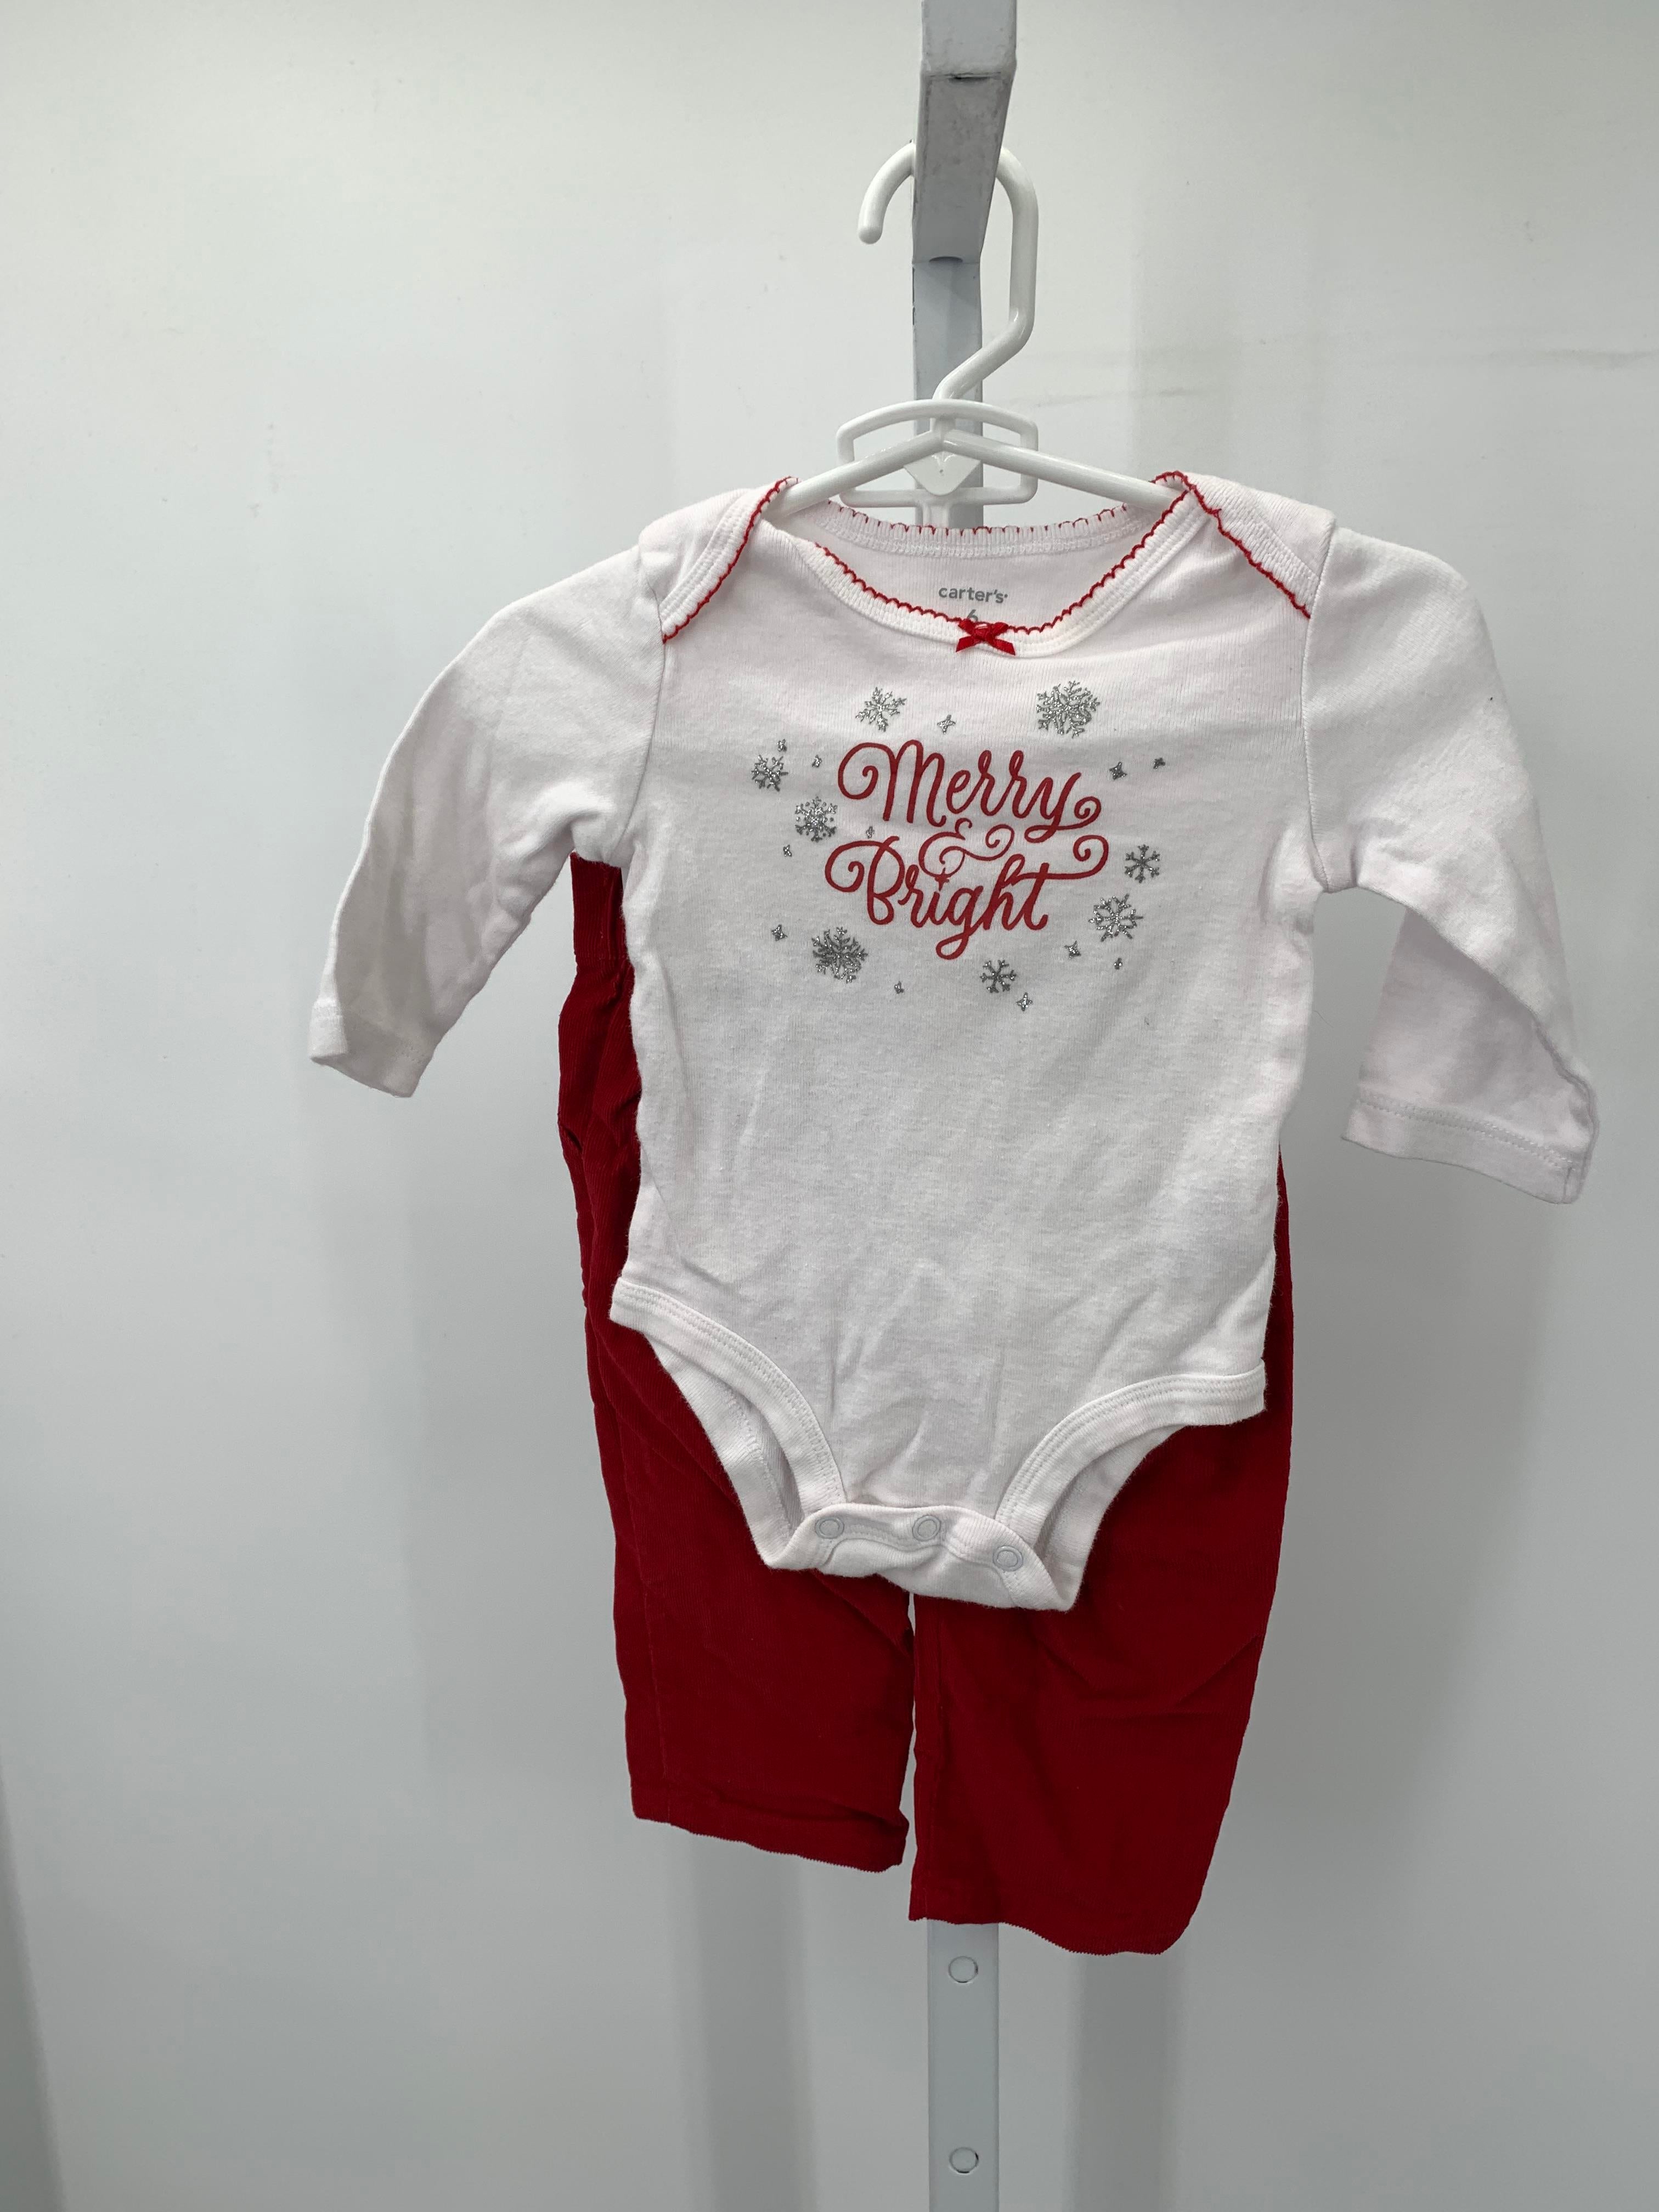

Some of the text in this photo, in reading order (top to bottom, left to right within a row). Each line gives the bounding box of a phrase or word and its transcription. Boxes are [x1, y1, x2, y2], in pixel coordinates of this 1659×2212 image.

[838, 739, 1102, 843] Merry
[825, 834, 1109, 960] Bright
[918, 817, 1015, 878] &
